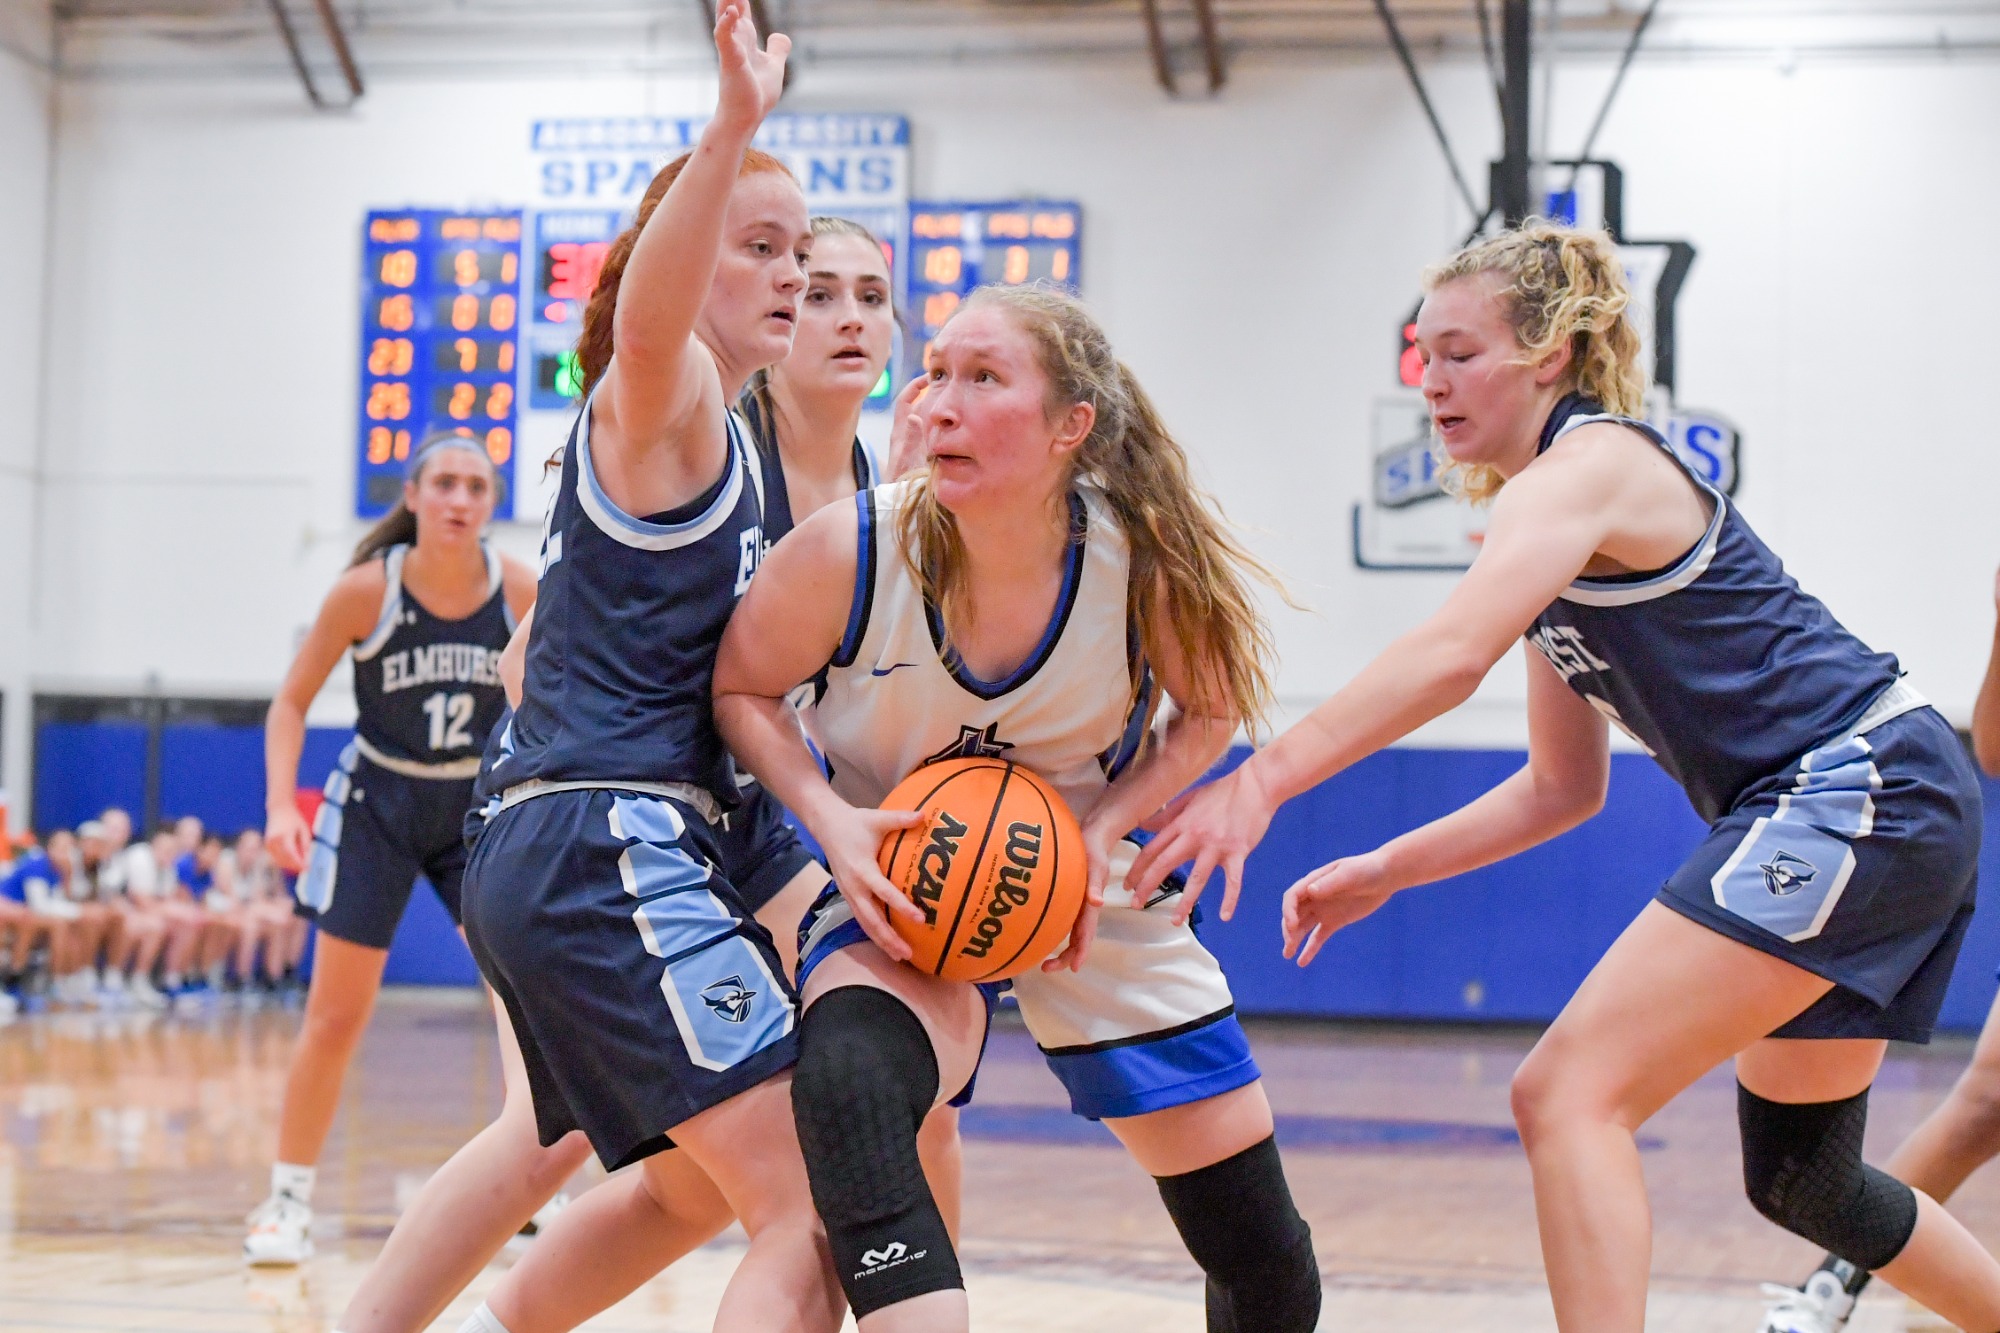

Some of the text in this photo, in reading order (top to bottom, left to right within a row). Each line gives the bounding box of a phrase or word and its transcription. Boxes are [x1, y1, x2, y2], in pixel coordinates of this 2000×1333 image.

[541, 157, 894, 197] SPANS
[502, 252, 518, 284] 1
[1052, 248, 1069, 281] 1
[498, 340, 515, 372] 1
[449, 382, 476, 420] 2
[486, 382, 513, 420] 2
[382, 642, 504, 693] ELMHURS
[422, 691, 475, 751] 12
[961, 820, 1043, 959] Wilson
